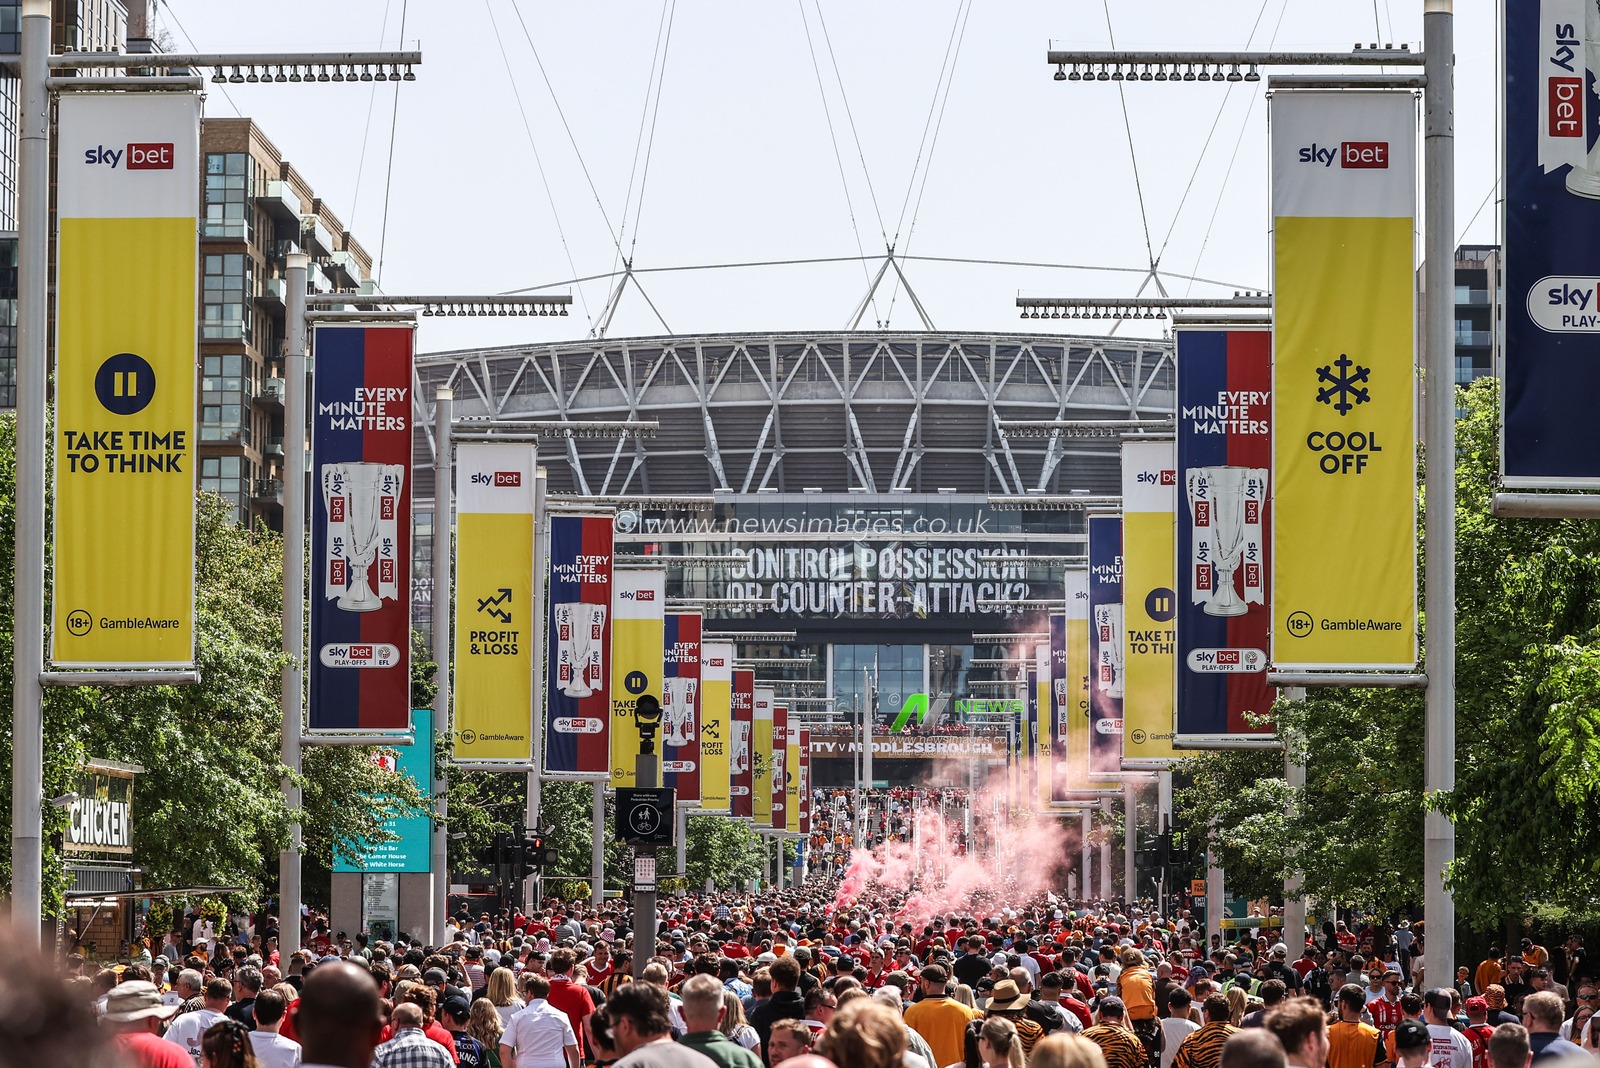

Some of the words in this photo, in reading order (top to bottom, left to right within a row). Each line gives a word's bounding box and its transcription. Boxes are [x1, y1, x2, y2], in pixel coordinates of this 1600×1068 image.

[1550, 24, 1580, 72] sky
[1556, 84, 1580, 130] bet
[85, 145, 123, 168] sky
[132, 146, 169, 164] bet
[1299, 143, 1338, 167] sky
[1346, 144, 1384, 162] bet
[1548, 284, 1593, 310] sky
[354, 388, 408, 402] EVERY
[1218, 391, 1270, 405] EVERY
[330, 416, 406, 430] MATTERS
[1194, 420, 1268, 434] MATTERS
[64, 431, 123, 450] TAKE
[129, 431, 186, 450] TIME
[1307, 431, 1382, 452] COOL
[66, 454, 99, 473] TO
[1320, 454, 1368, 474] OFF
[332, 473, 344, 495] sky
[382, 475, 394, 494] sky
[471, 472, 492, 486] sky
[497, 473, 518, 484] bet
[1137, 471, 1158, 484] sky
[1196, 478, 1208, 499] sky
[1246, 479, 1258, 498] sky
[334, 500, 343, 520] bet
[384, 498, 393, 518] bet
[1198, 503, 1208, 524] bet
[1248, 503, 1256, 522] bet
[331, 537, 344, 558] sky
[381, 538, 393, 557] sky
[1197, 541, 1209, 562] sky
[1246, 542, 1258, 561] sky
[576, 555, 609, 565] EVERY
[730, 547, 854, 580] CONTROL
[860, 547, 1029, 580] POSSESSION
[333, 562, 343, 582] bet
[383, 561, 392, 580] bet
[560, 574, 608, 583] MATTERS
[1199, 567, 1209, 587] bet
[1248, 566, 1257, 585] bet
[620, 591, 635, 600] sky
[70, 618, 89, 628] 18+
[100, 617, 179, 629] GambleAware
[1290, 620, 1310, 629] 18+
[1321, 619, 1402, 630] GambleAware
[470, 631, 519, 642] PROFIT
[1128, 631, 1161, 641] TAKE
[329, 647, 348, 658] sky
[351, 648, 371, 657] bet
[470, 644, 480, 655] &
[484, 644, 518, 655] LOSS
[1130, 643, 1148, 654] TO
[1196, 652, 1215, 663] sky
[1219, 652, 1237, 661] bet
[848, 742, 992, 753] MDDLESBROUGH
[70, 798, 128, 846] CHICKEN
